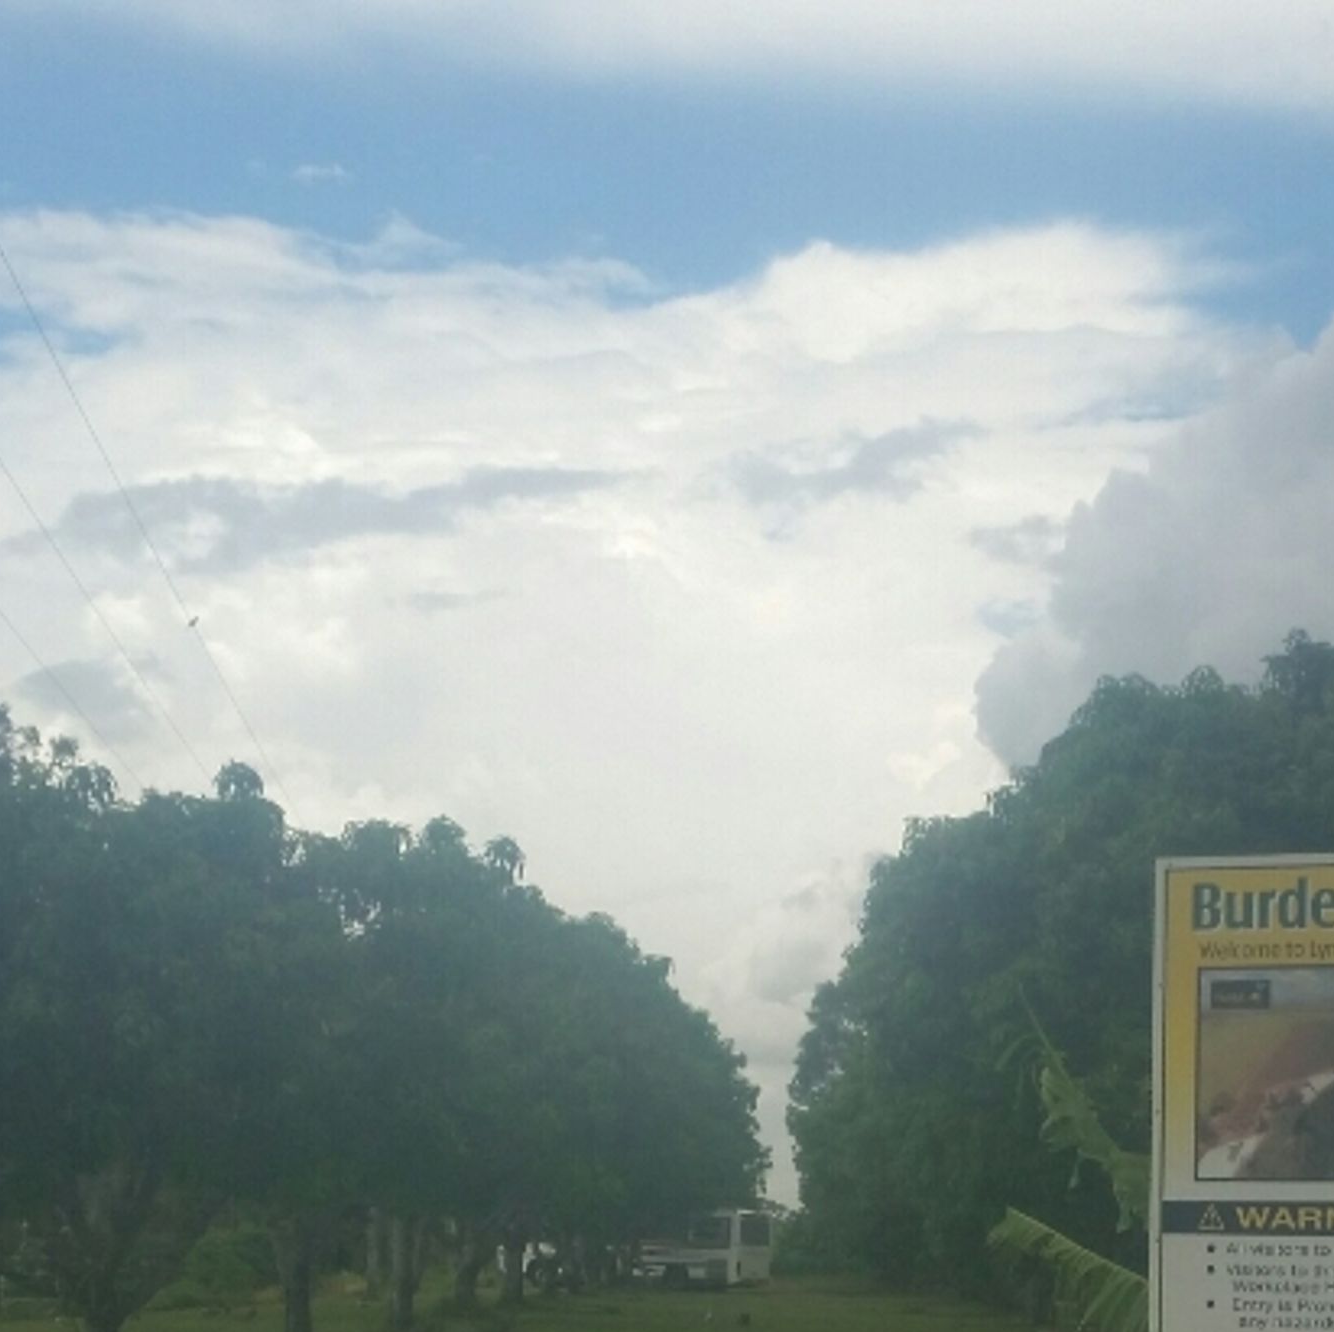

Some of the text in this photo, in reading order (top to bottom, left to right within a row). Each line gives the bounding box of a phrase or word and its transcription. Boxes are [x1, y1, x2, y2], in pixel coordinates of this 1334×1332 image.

[1200, 941, 1282, 959] Welcome
[1285, 941, 1305, 959] to
[1314, 1244, 1332, 1257] to
[1291, 1264, 1309, 1278] to
[1232, 1281, 1321, 1296] Workplace
[1232, 1298, 1274, 1315] Entry
[1239, 1316, 1270, 1331] any
